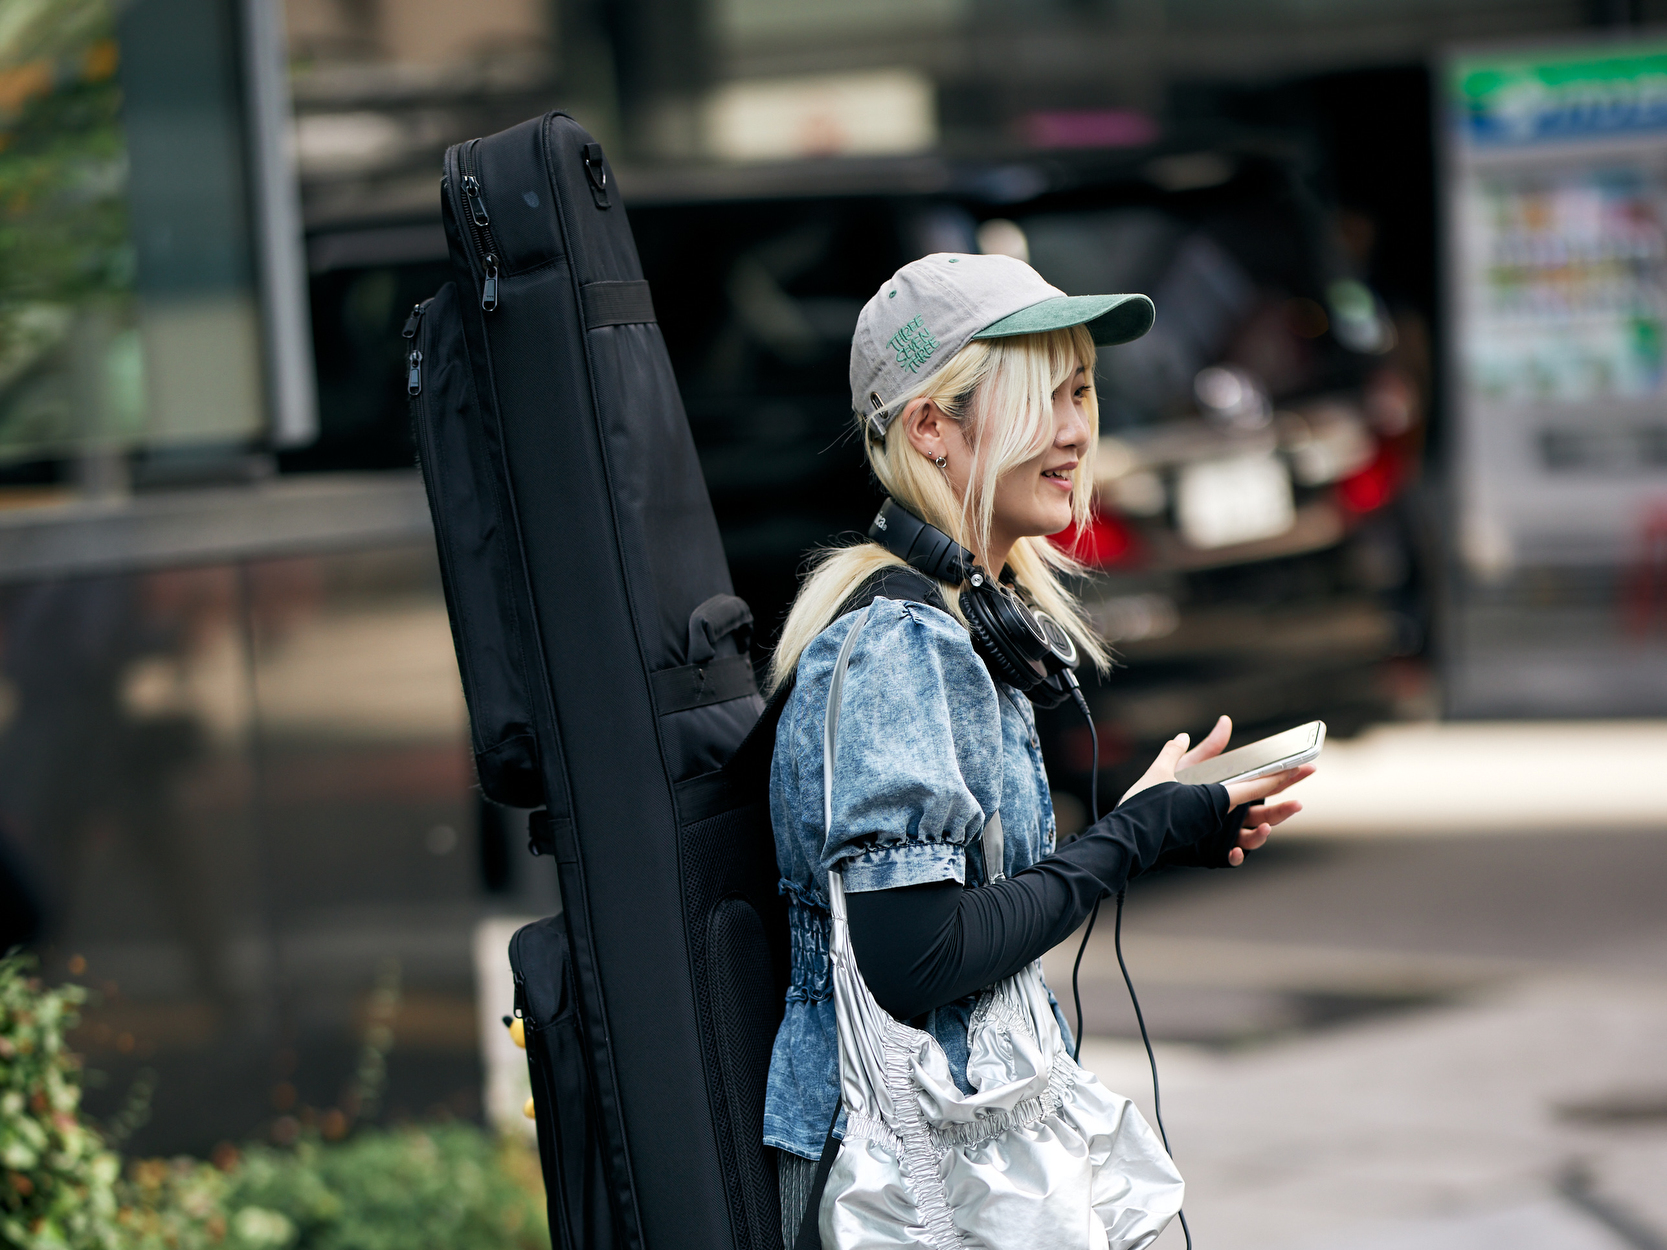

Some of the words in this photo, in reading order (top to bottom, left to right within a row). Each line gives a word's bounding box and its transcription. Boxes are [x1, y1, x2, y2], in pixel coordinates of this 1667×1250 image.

[886, 313, 925, 351] THREE
[896, 327, 931, 368] SEVEN
[904, 335, 941, 374] THREE
